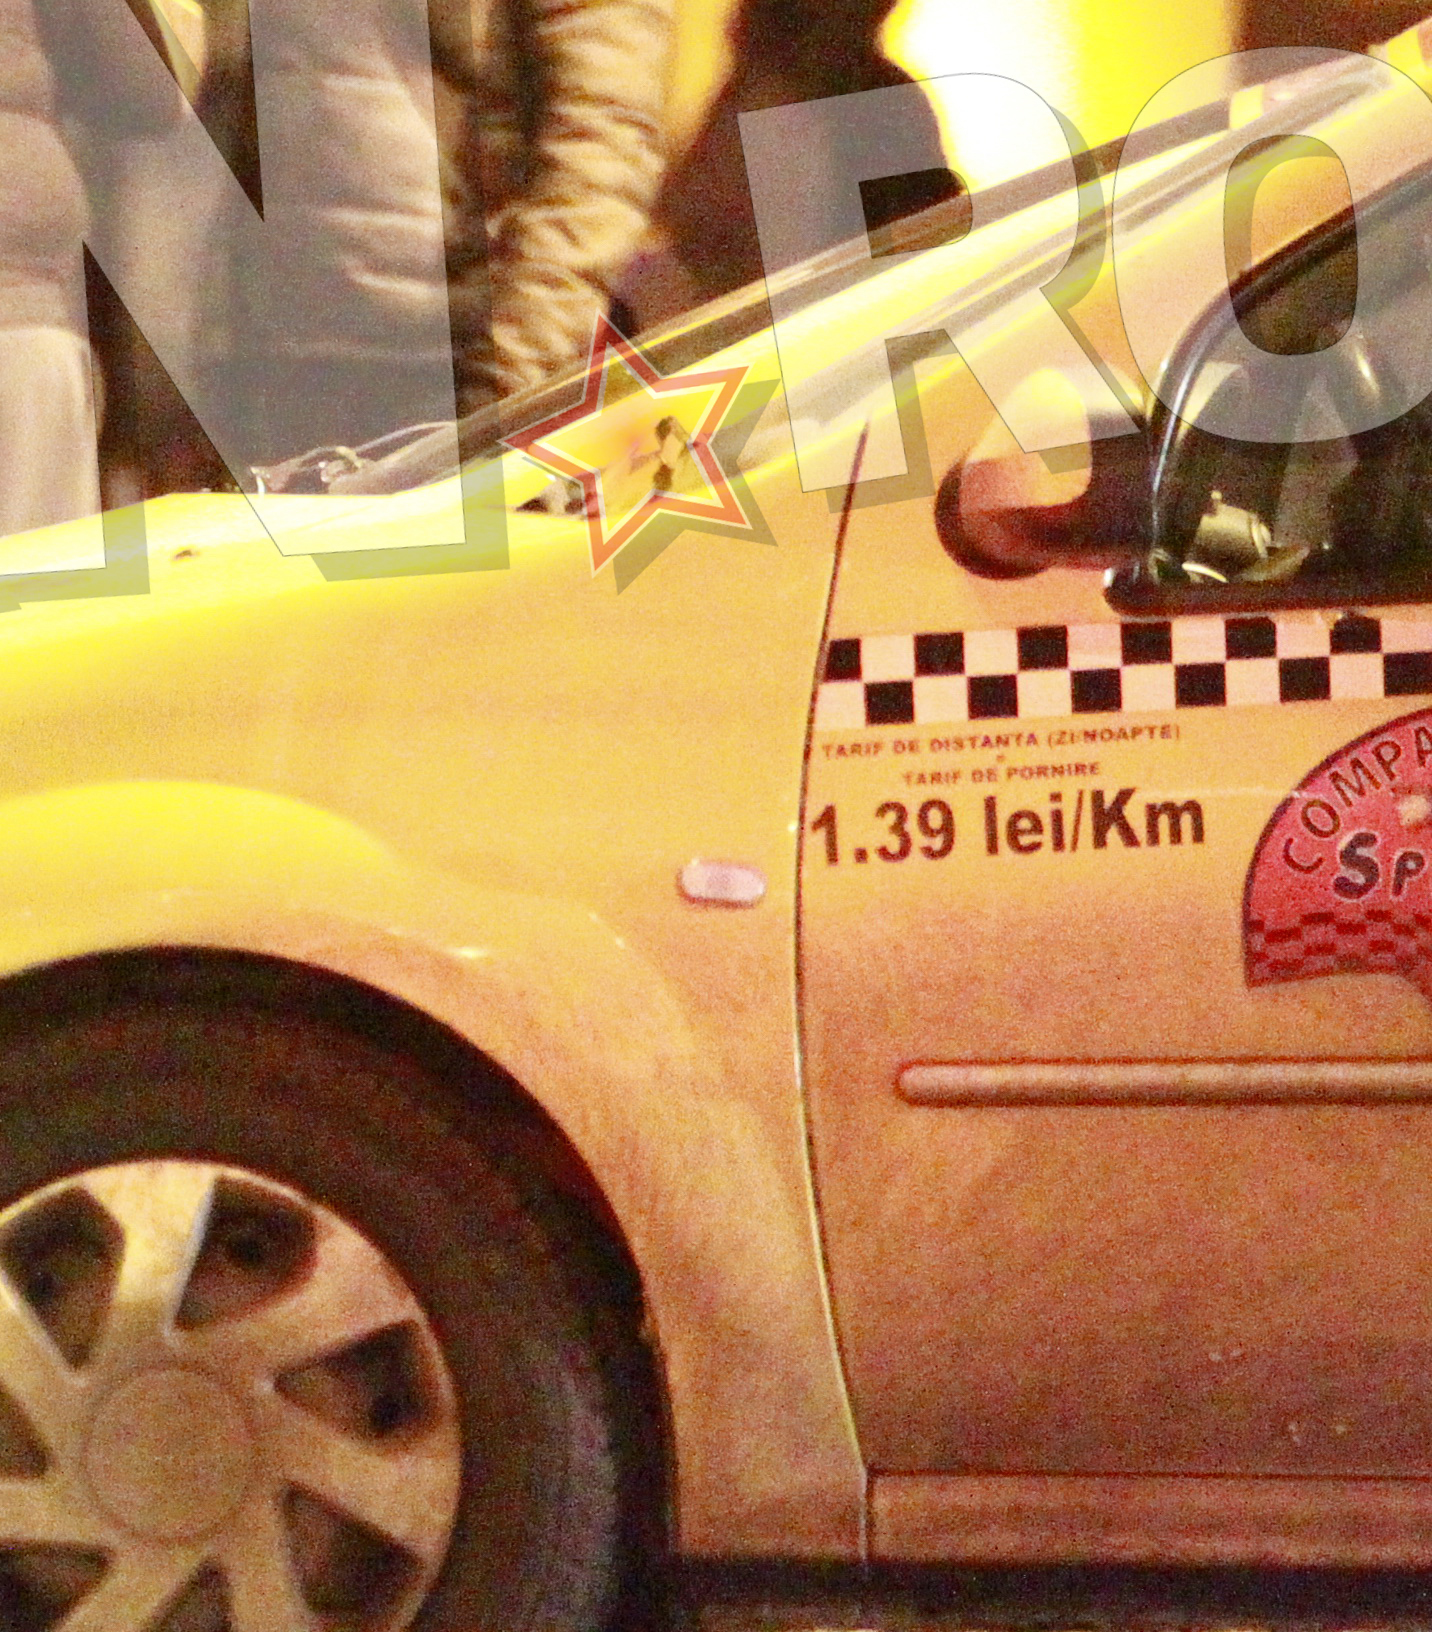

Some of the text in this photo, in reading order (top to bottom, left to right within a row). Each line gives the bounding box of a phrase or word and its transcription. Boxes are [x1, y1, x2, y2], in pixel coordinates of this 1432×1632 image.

[822, 741, 884, 761] TARIF
[893, 738, 920, 755] DE
[903, 762, 1100, 786] TARIF DE PORNIRE
[810, 787, 1205, 866] 1.39 lei/Km
